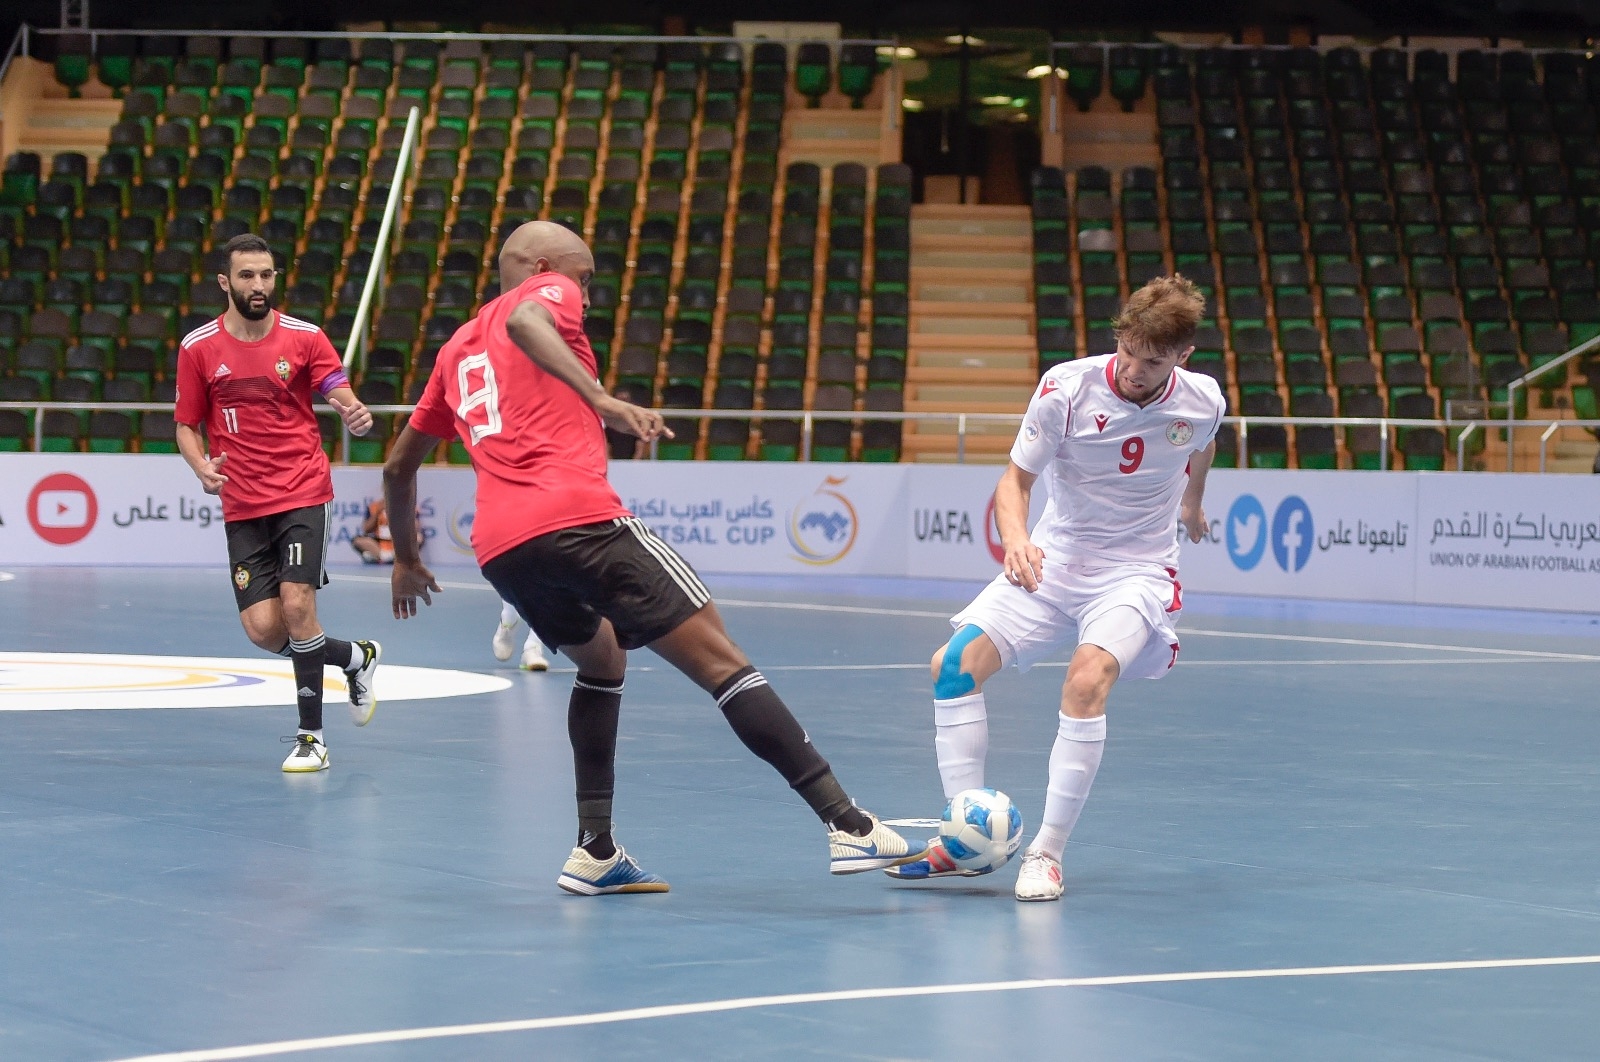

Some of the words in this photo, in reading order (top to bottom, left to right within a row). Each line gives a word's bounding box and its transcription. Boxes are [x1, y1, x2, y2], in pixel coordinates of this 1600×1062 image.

[457, 349, 503, 447] 8
[221, 407, 239, 434] 11
[1118, 436, 1145, 475] 9
[113, 495, 169, 528] على
[670, 499, 723, 522] العرب
[726, 495, 774, 522] كأس
[652, 525, 717, 545] TSAL
[726, 525, 775, 545] CUP
[914, 508, 974, 543] UAFA
[1318, 518, 1352, 551] على
[1357, 519, 1409, 554] تابعونا
[1430, 511, 1487, 546] القدم
[1492, 511, 1545, 548] لكرة
[288, 542, 302, 566] 11
[1430, 553, 1464, 567] UNION
[1465, 553, 1481, 568] OF
[1483, 554, 1530, 570] ARABIAN
[1531, 556, 1586, 572] FOOTBALL
